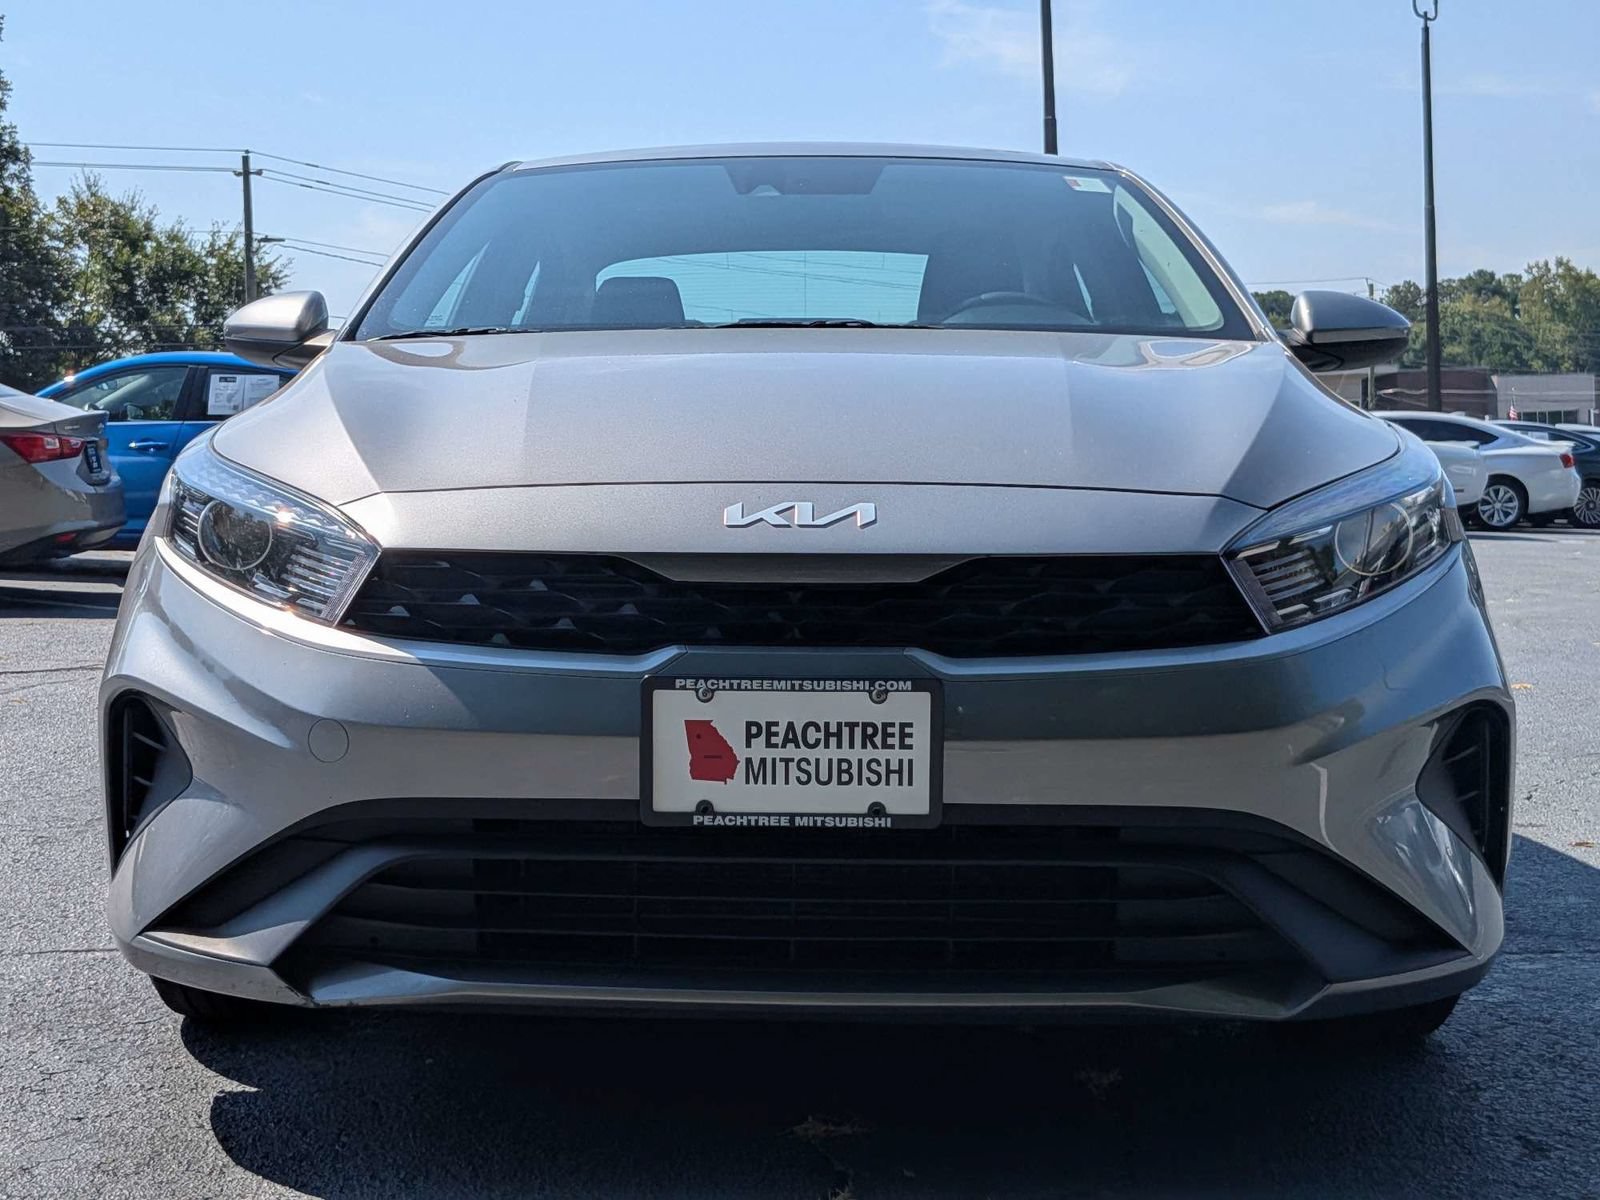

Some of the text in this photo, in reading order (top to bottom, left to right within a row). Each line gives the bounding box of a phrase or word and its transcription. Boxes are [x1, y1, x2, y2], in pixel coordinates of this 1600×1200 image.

[723, 501, 878, 529] KIA
[674, 678, 913, 692] PEACHTREEMITSUBISHI.COM
[744, 720, 914, 750] PEACHTREE
[744, 757, 914, 787] MITSUBISHI
[692, 814, 892, 829] PEACHTREE MITSUBISHI
